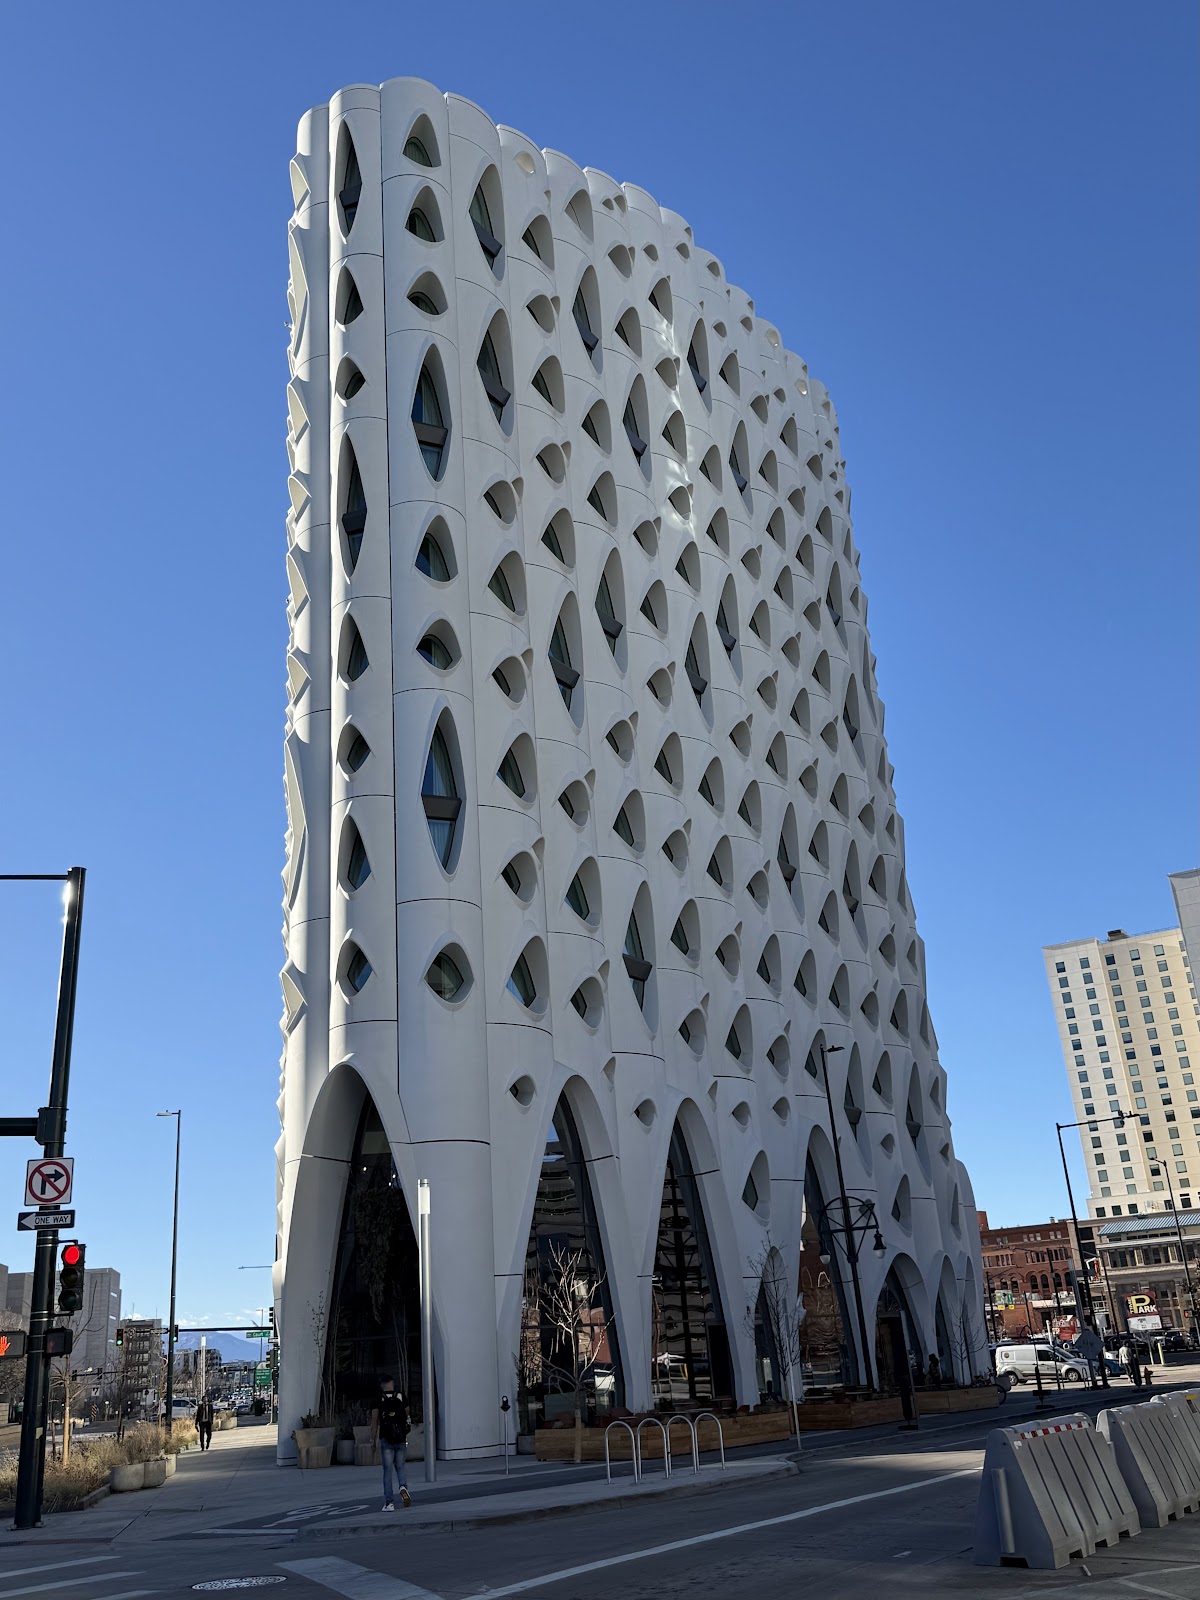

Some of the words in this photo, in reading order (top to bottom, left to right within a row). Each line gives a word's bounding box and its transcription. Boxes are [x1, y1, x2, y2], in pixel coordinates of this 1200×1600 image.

[34, 1216, 50, 1224] ONE
[52, 1216, 68, 1224] WAY
[1131, 1295, 1157, 1314] PARK
